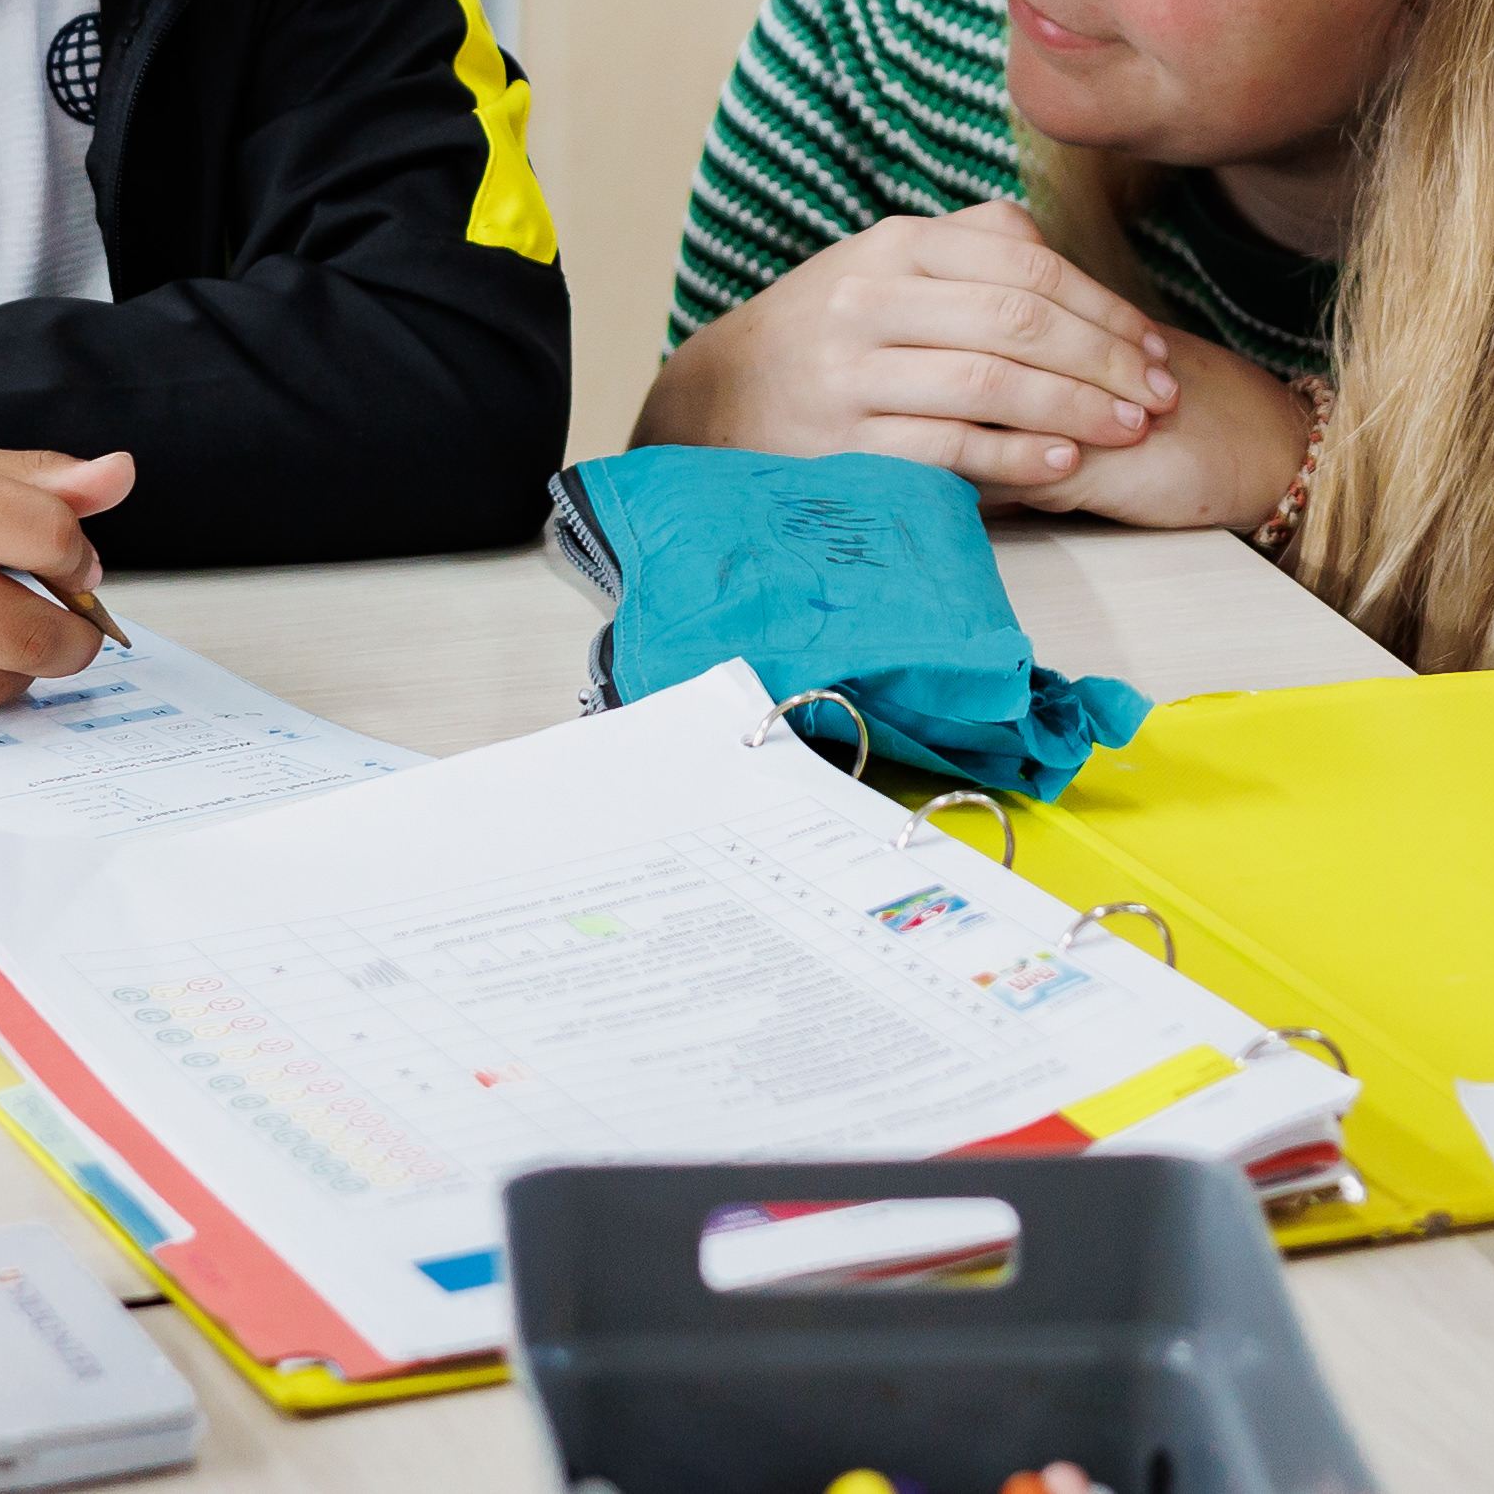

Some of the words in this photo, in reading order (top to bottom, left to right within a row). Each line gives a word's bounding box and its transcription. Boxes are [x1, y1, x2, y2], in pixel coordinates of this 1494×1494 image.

[206, 741, 257, 753] Welke
[141, 749, 204, 766] getallen
[26, 772, 89, 789] maken?
[285, 773, 353, 791] Hoeveel
[195, 796, 237, 810] getal
[136, 807, 194, 825] waard?
